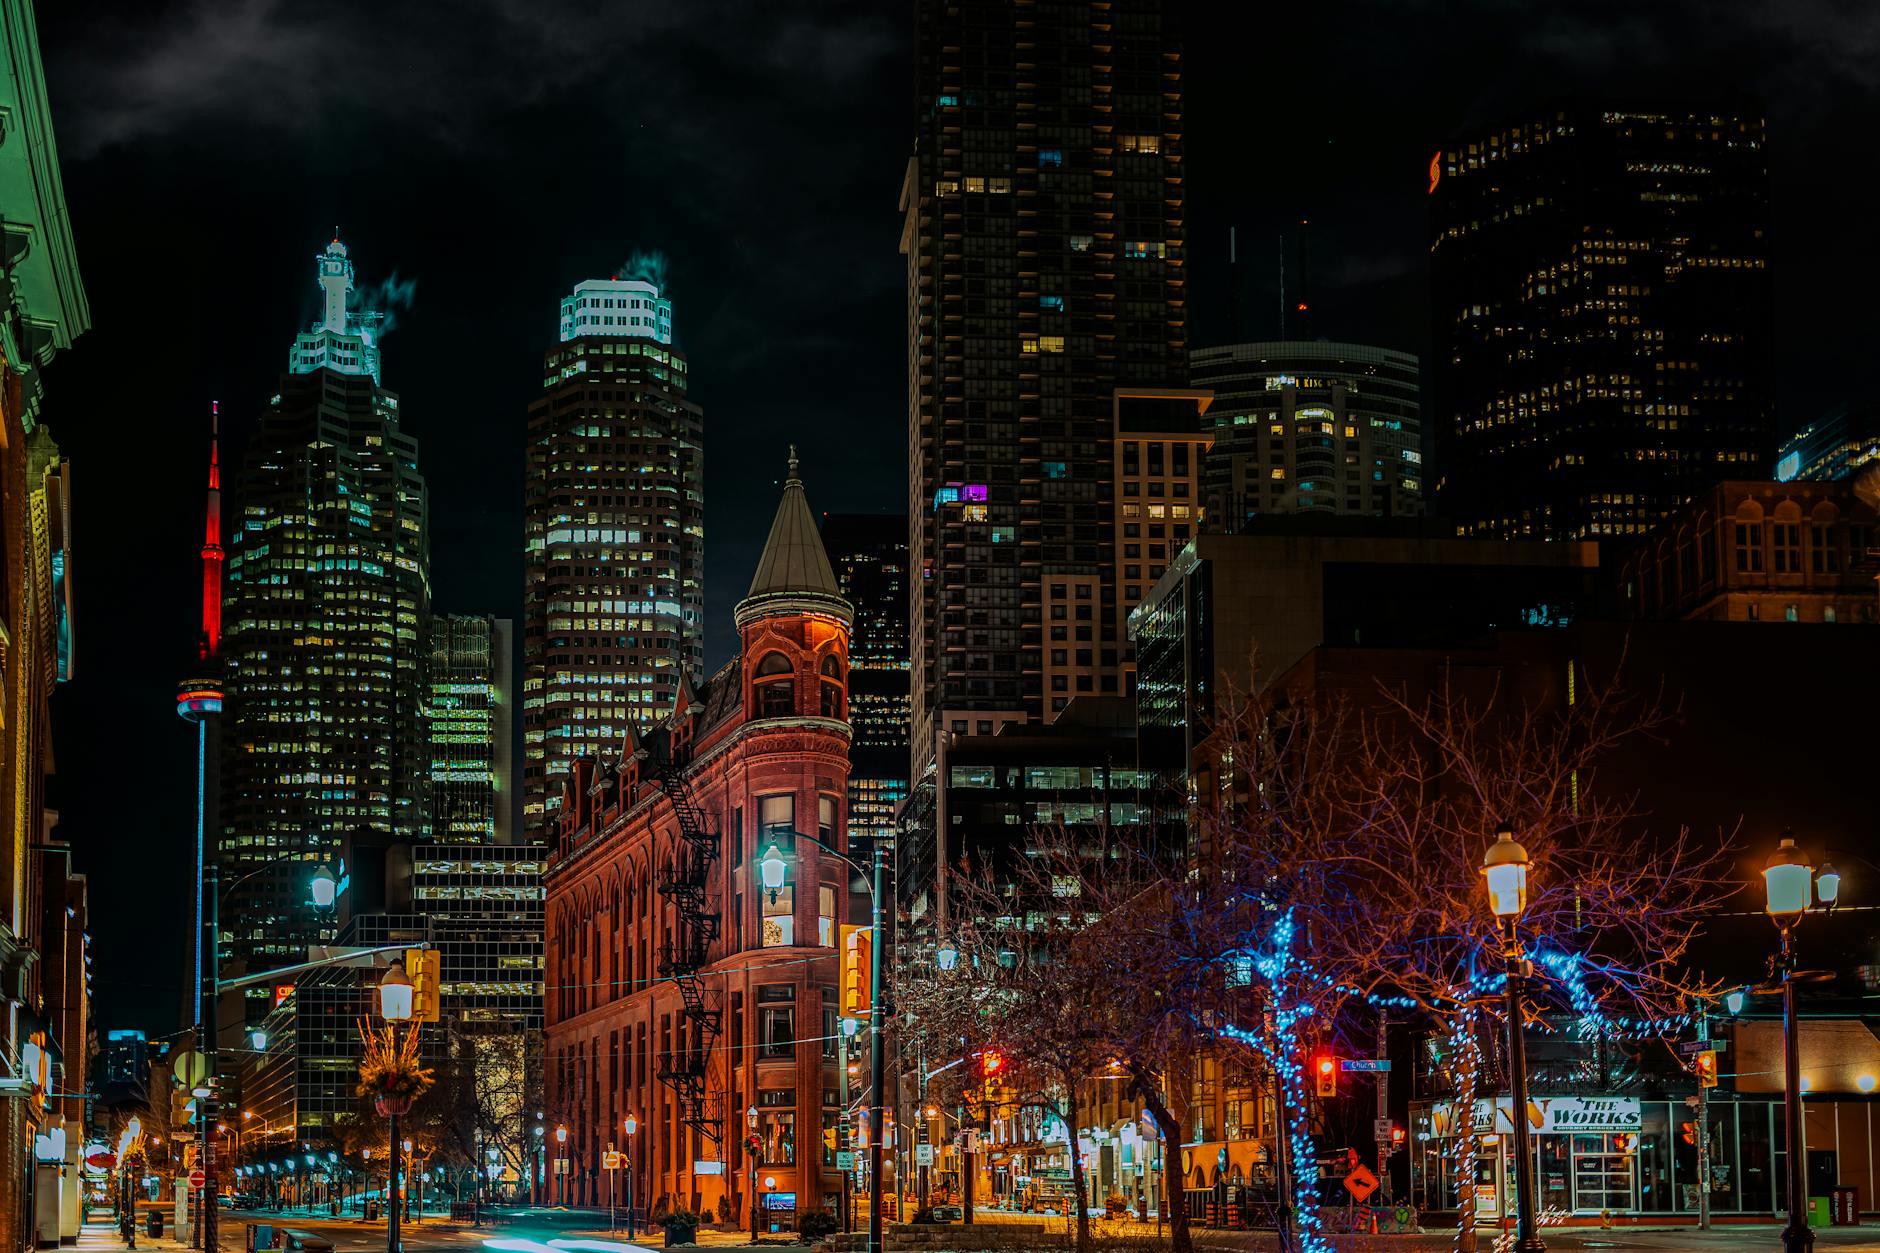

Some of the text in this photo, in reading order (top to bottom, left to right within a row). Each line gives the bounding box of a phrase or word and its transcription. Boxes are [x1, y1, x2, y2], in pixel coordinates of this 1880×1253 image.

[325, 261, 342, 273] TD
[1304, 378, 1323, 388] KING
[1351, 1061, 1376, 1069] Church
[1583, 1100, 1619, 1111] THE
[1553, 1109, 1641, 1124] WORKS
